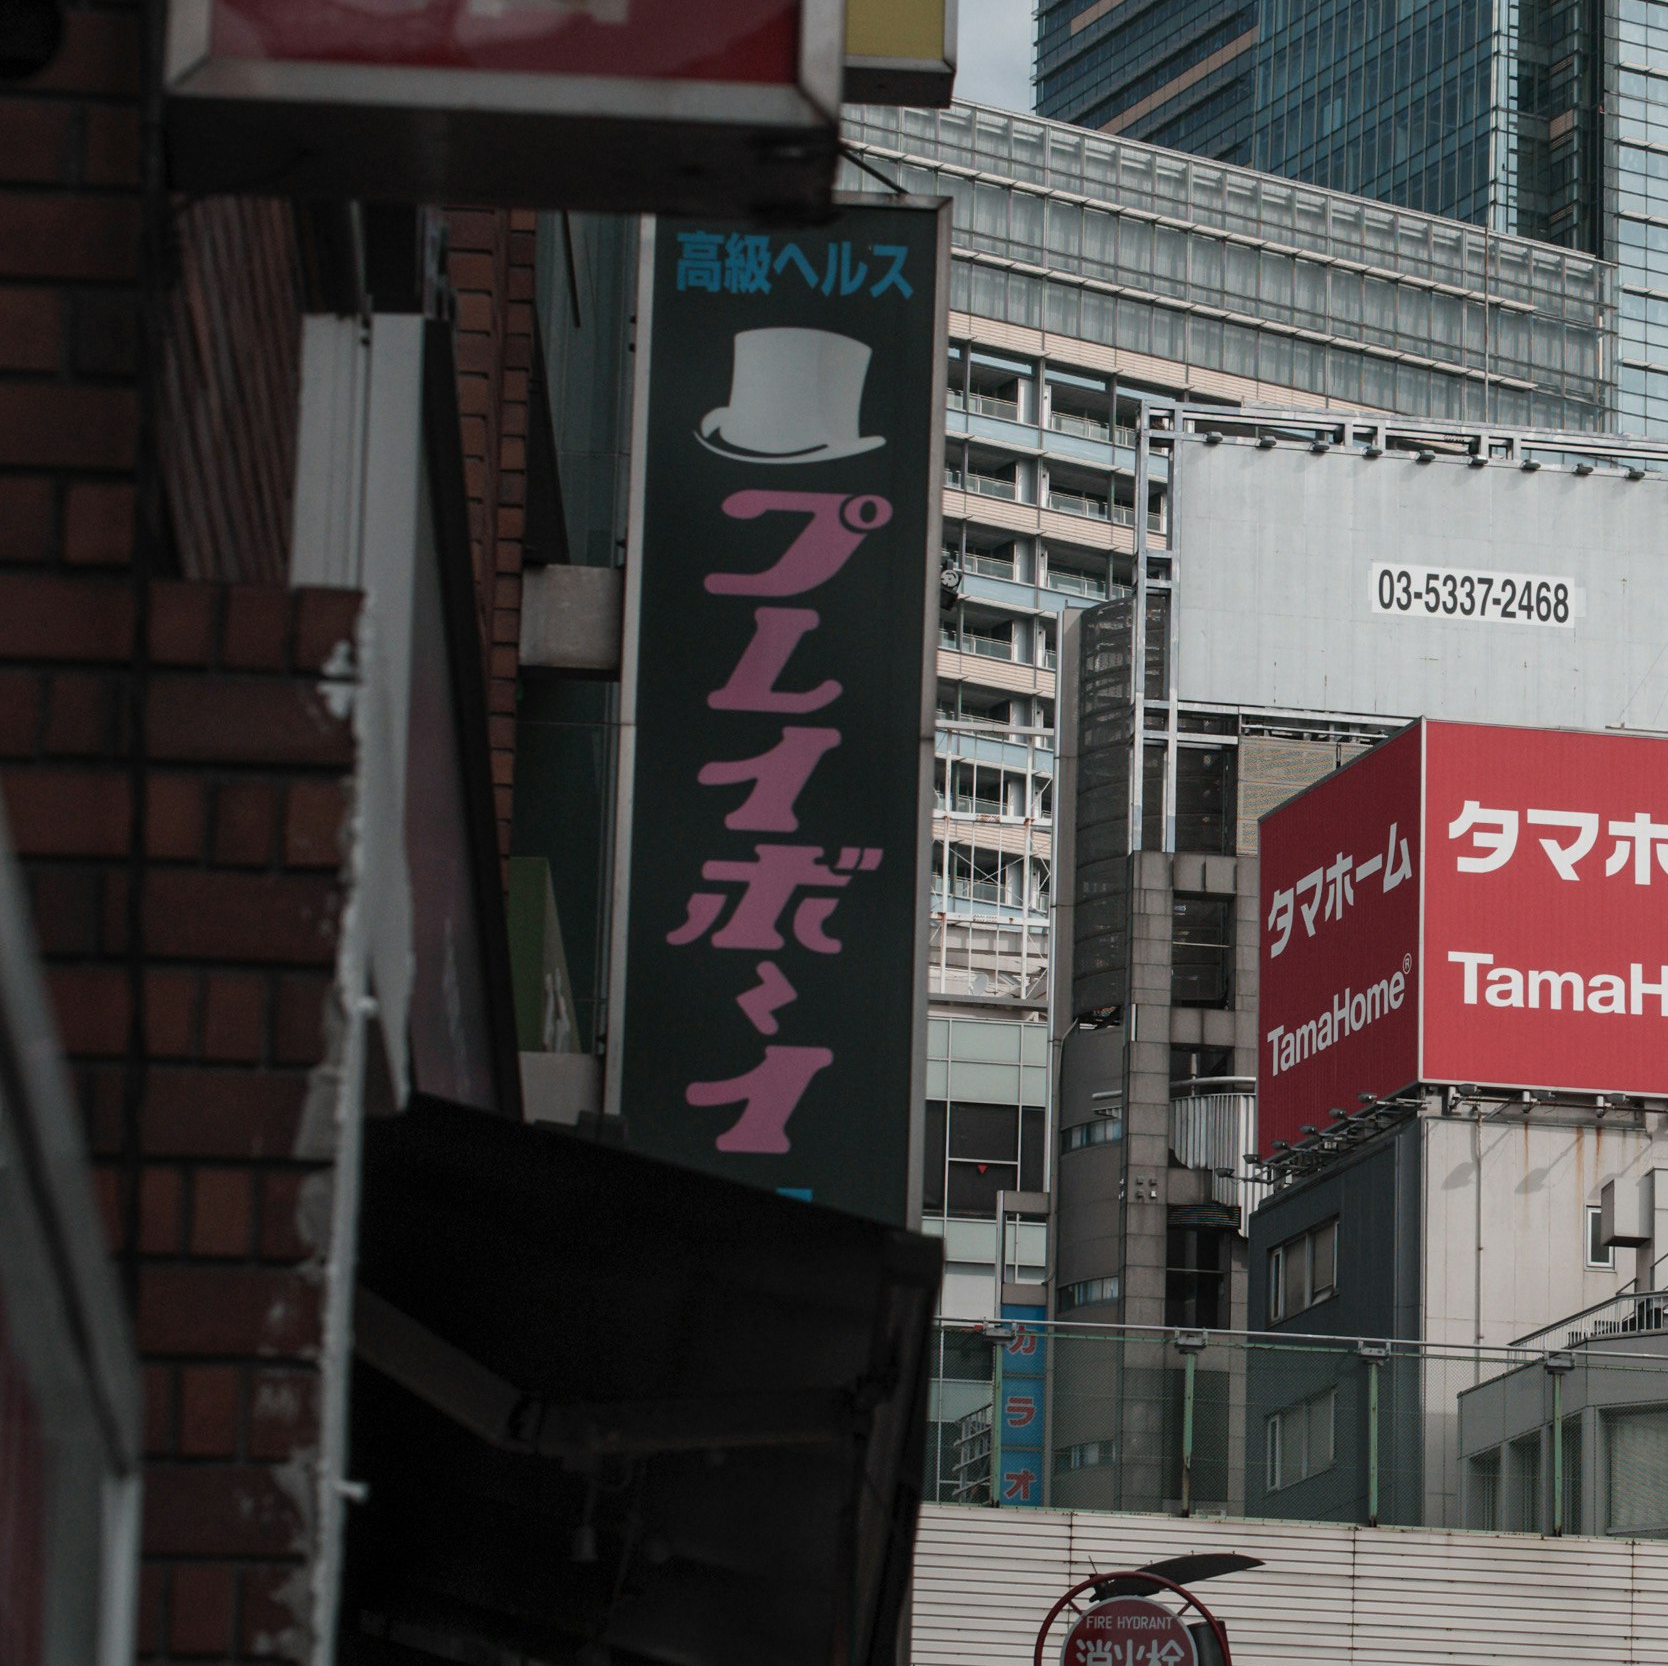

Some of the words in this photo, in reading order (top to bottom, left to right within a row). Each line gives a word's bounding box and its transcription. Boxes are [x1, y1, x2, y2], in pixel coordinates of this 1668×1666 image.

[676, 230, 914, 300] 高級ヘルス
[1377, 568, 1570, 624] 03-5337-2468
[665, 489, 893, 1154] プレイボーイ
[1267, 821, 1413, 960] タマホーム
[1086, 1615, 1112, 1630] FIRE
[1117, 1615, 1173, 1630] HYDRANT
